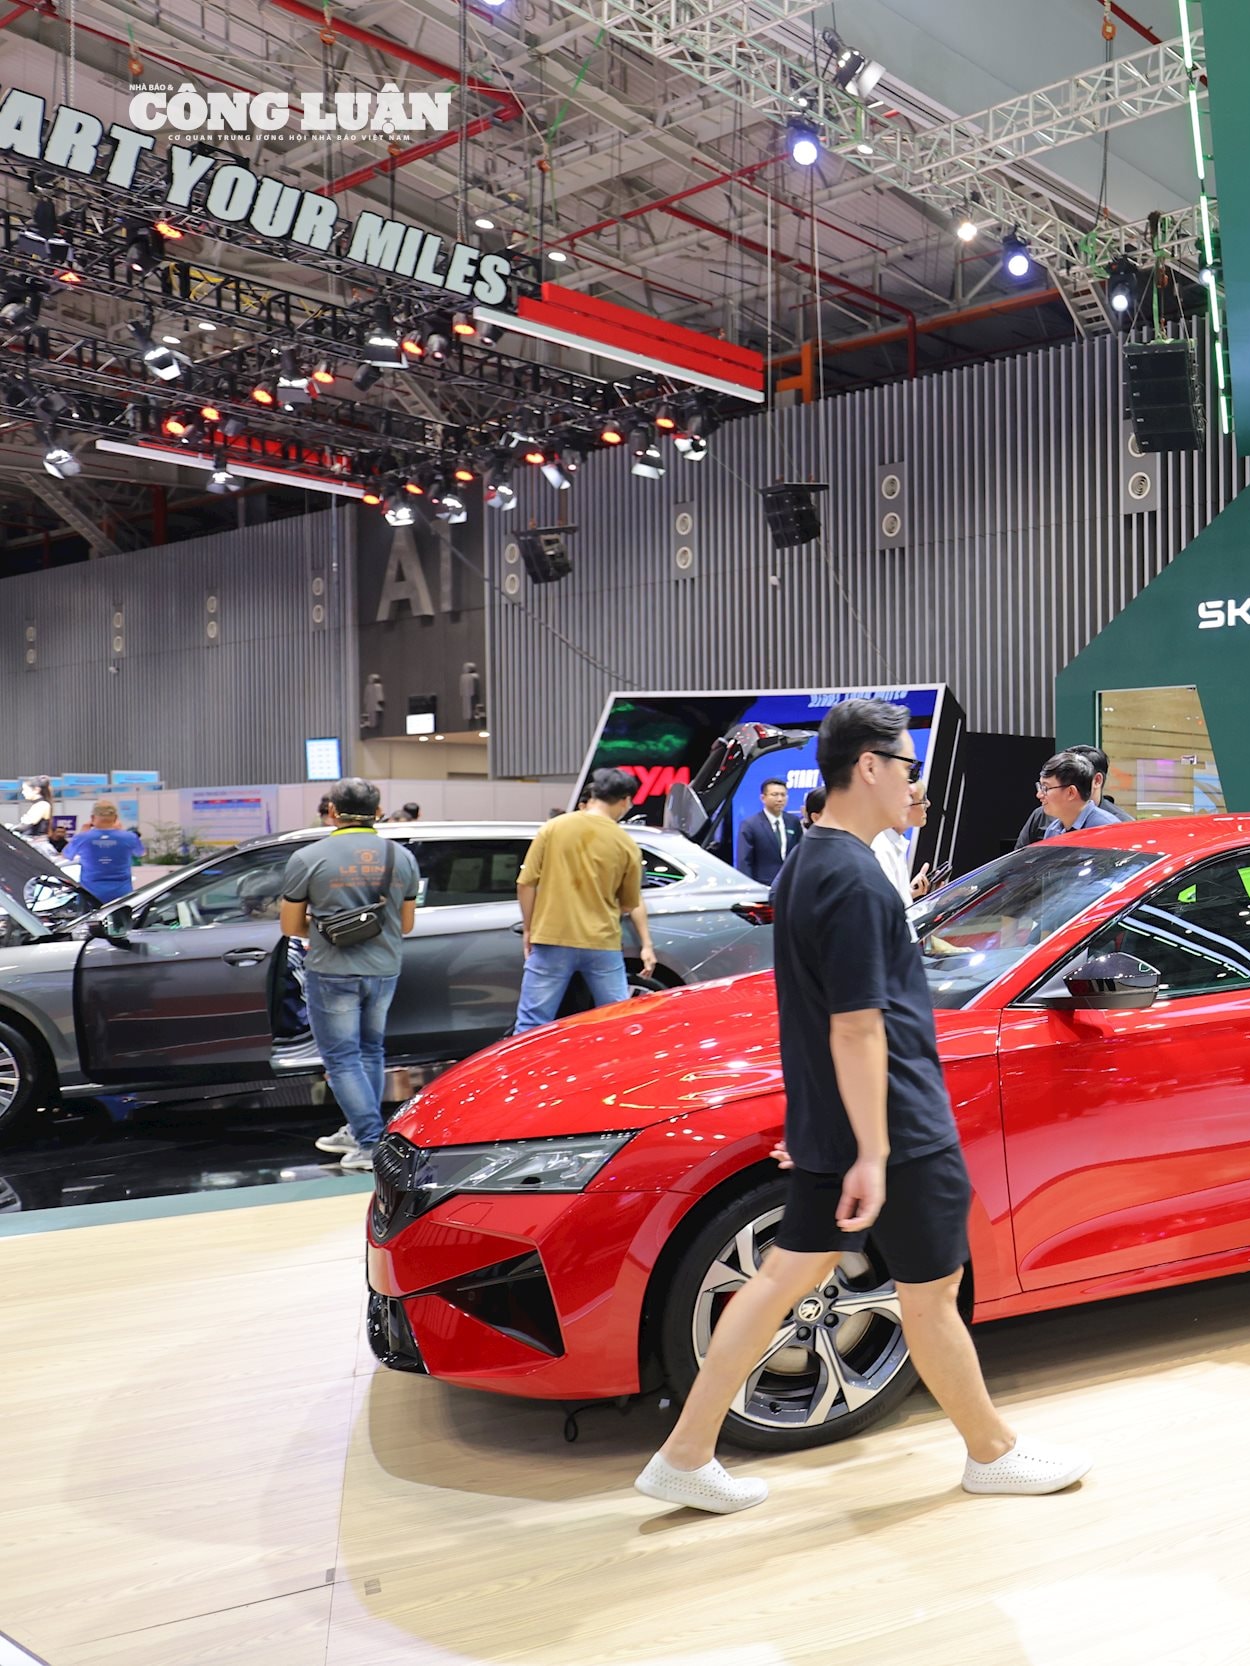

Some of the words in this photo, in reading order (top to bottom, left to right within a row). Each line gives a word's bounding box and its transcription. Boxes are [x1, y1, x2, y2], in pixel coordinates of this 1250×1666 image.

[166, 145, 338, 251] YOUR
[347, 210, 511, 305] MILES
[616, 765, 691, 805] YM
[786, 769, 820, 788] START
[361, 865, 385, 874] BIN
